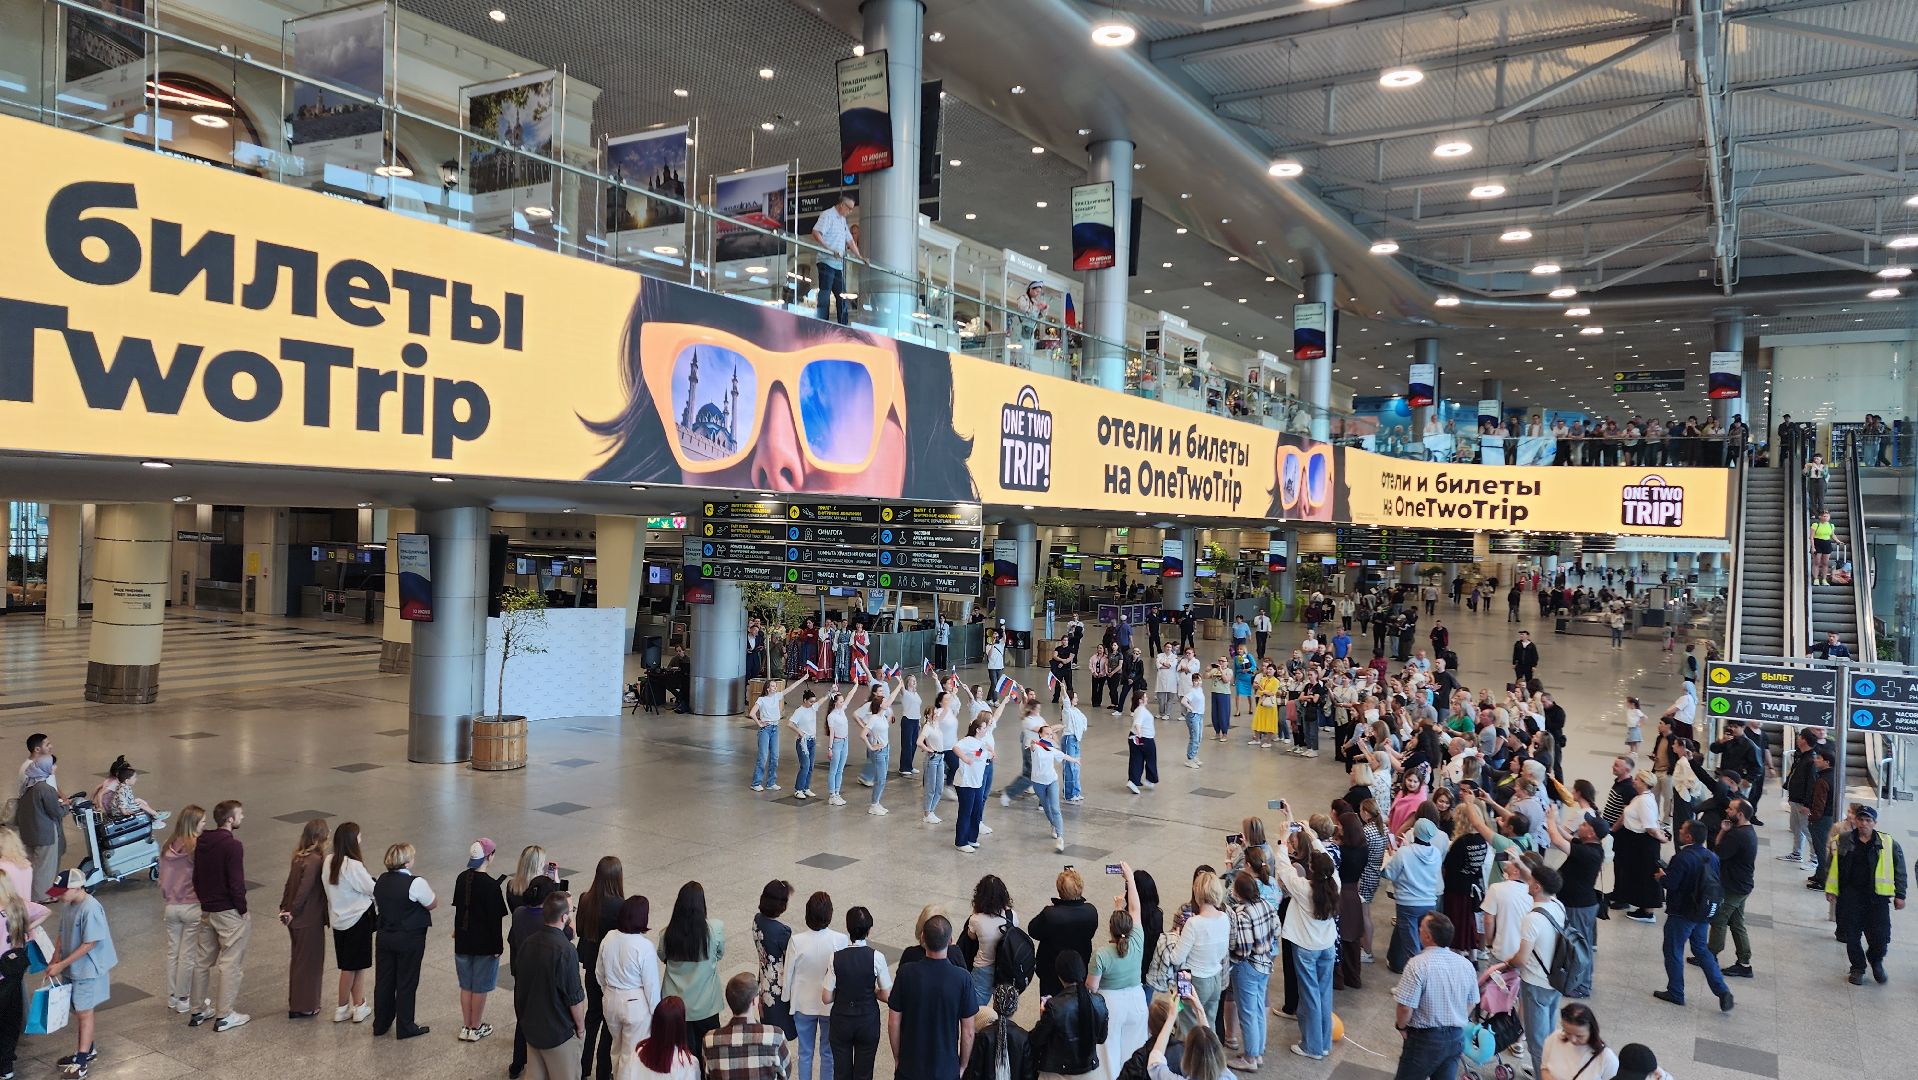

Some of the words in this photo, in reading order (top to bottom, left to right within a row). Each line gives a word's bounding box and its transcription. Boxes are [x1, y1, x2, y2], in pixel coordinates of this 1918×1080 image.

[46, 180, 524, 352] билеты
[0, 297, 491, 460] TwoTrip
[1003, 408, 1026, 436] ONE
[1028, 412, 1051, 440] TWO
[1098, 415, 1163, 453] отели
[1169, 428, 1181, 457] и
[1187, 424, 1250, 467] билеты
[1002, 438, 1051, 488] TRIP!
[1104, 463, 1131, 495] на
[1138, 459, 1242, 512] OneTwoTrip
[1381, 471, 1412, 491] отели
[1417, 476, 1428, 493] и
[1436, 471, 1541, 496] билеты
[1623, 486, 1650, 500] ONE
[1651, 487, 1683, 501] TWO
[1396, 495, 1529, 526] OneTwoTrip
[1622, 501, 1682, 526] TRIP!
[674, 572, 683, 581] 62
[935, 578, 957, 586] ТУАЛЕТ
[1761, 672, 1794, 681] ВЫЛЕТ
[1761, 682, 1795, 691] DEPARTURES
[1760, 702, 1798, 713] ТУАЛЕТ
